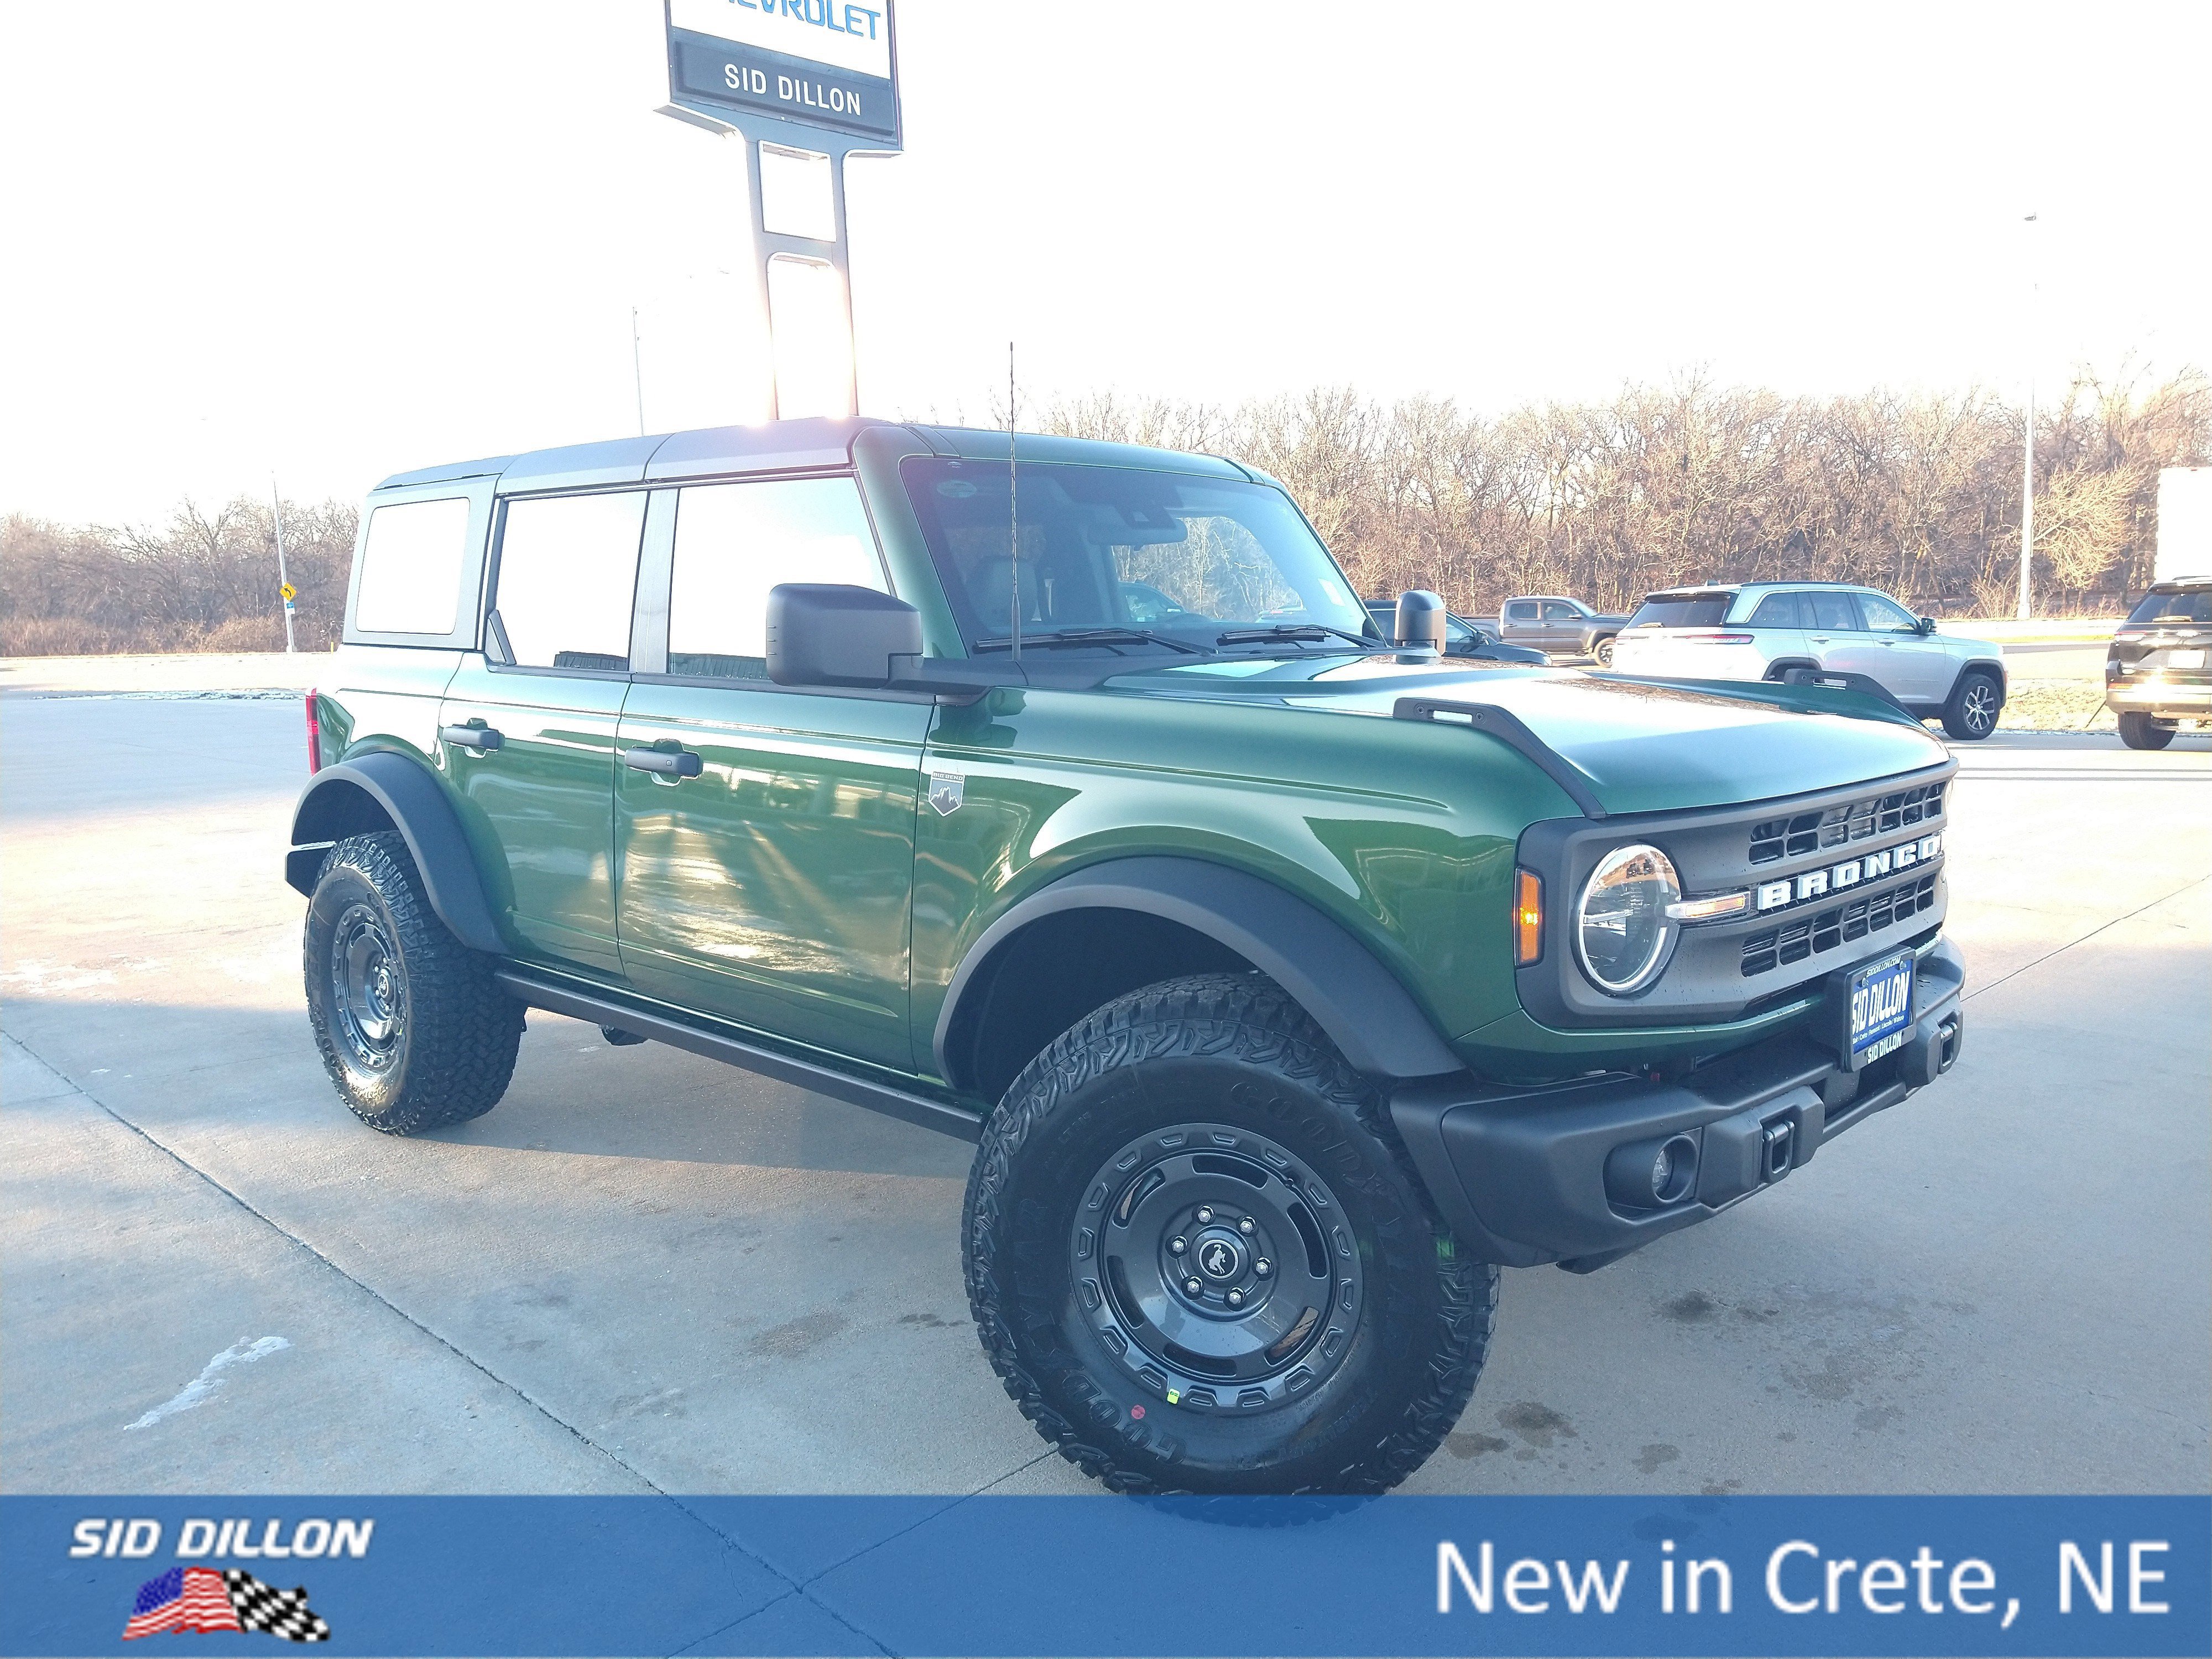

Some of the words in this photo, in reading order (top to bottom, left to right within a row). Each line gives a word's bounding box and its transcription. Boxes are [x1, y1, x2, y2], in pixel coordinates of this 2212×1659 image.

[729, 0, 881, 40] ROLET
[724, 64, 767, 95] SID
[779, 75, 860, 116] DILLON
[1757, 834, 1940, 910] BRONCO
[1853, 988, 1868, 1035] SID
[1868, 971, 1910, 1027] DILLON
[1867, 1046, 1879, 1065] SID
[1880, 1031, 1902, 1058] DILLON
